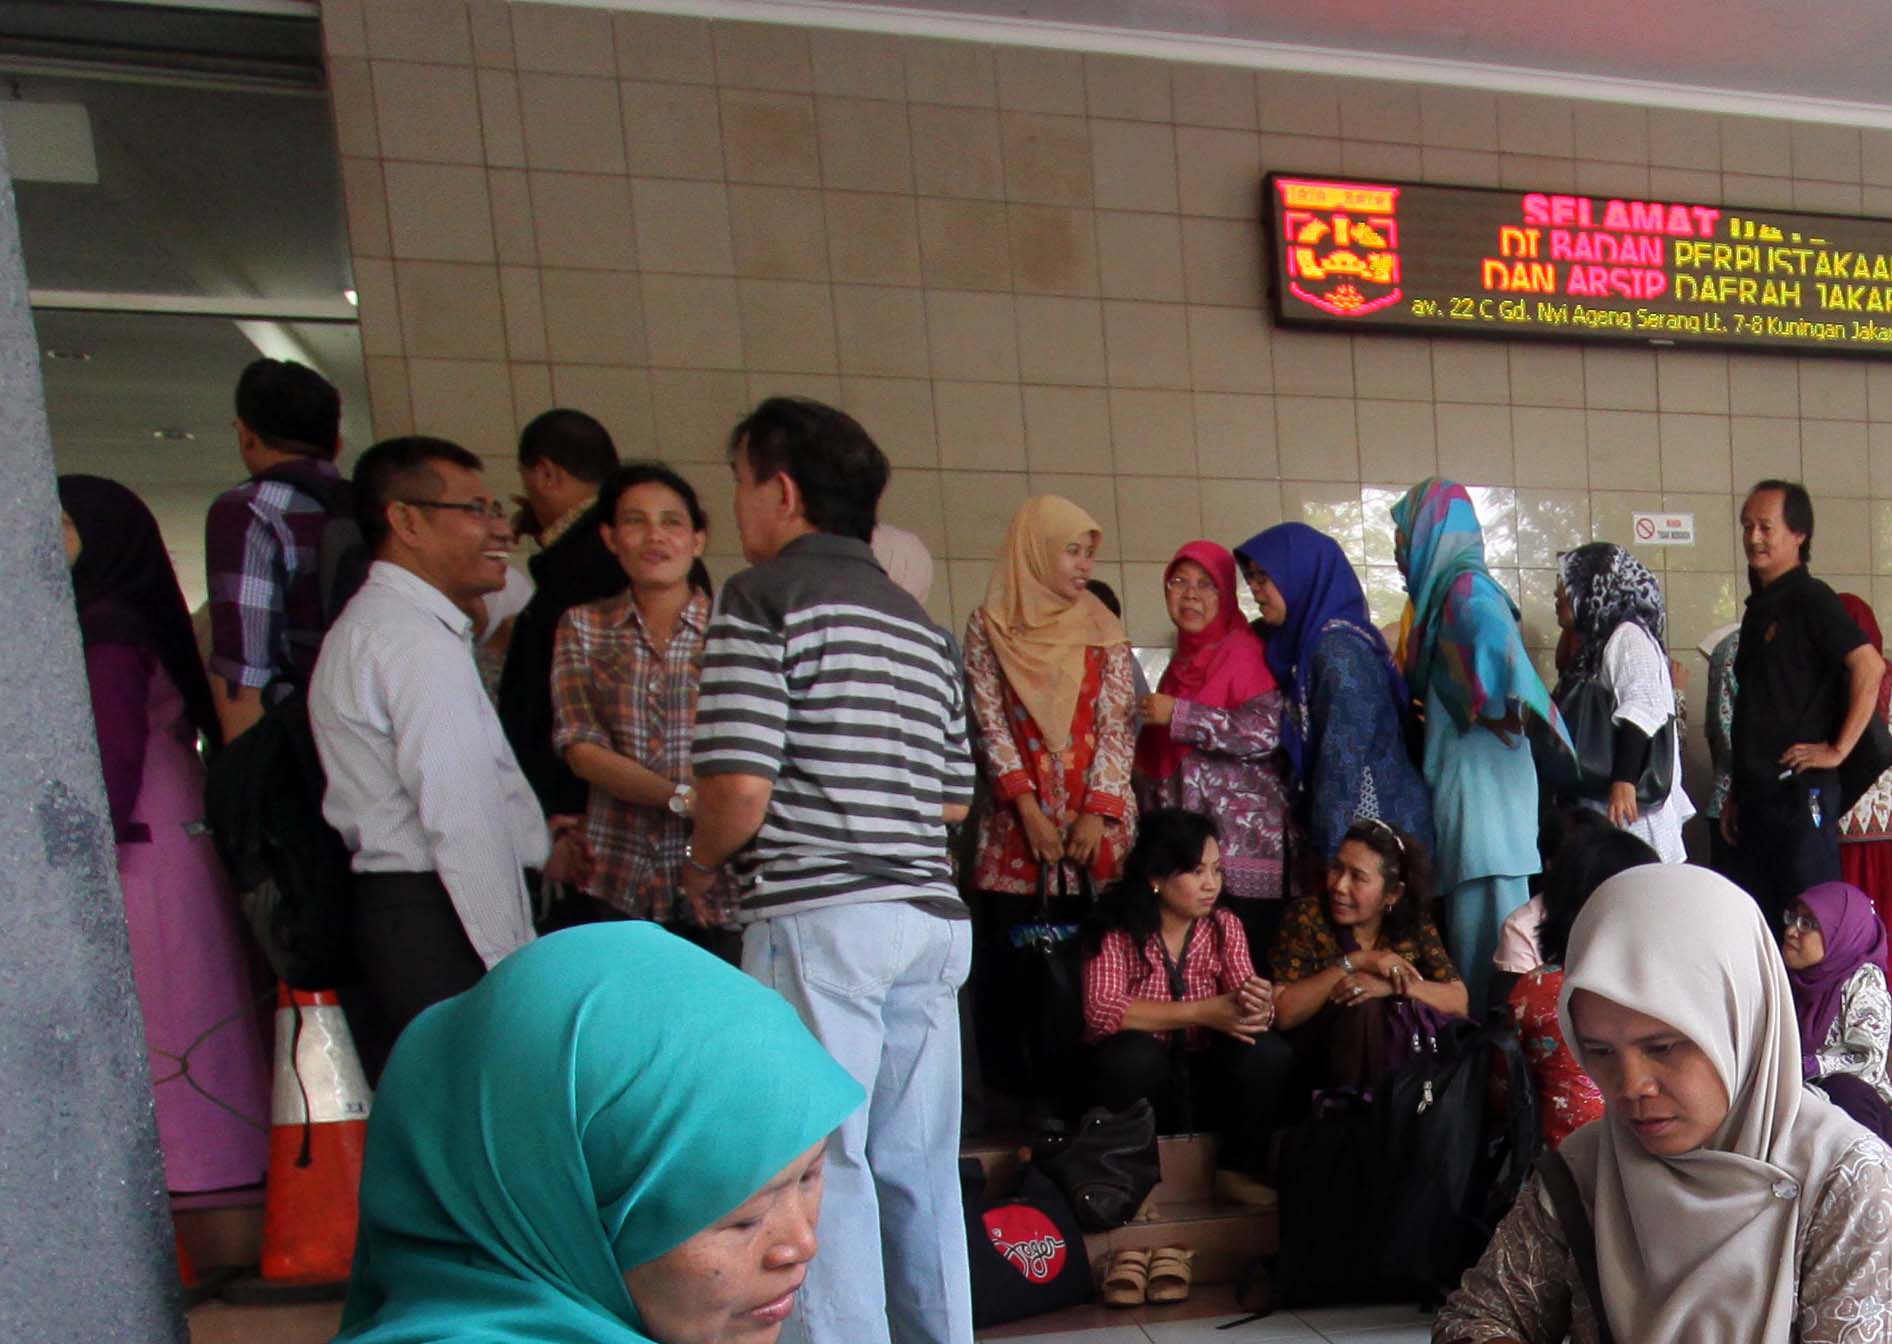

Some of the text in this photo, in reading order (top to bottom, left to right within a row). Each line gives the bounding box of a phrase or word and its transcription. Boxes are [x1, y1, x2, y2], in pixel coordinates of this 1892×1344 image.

[1481, 257, 1557, 295] DAN
[1450, 298, 1475, 319] 22
[1479, 299, 1494, 319] C
[1537, 303, 1569, 325] Nyi
[1573, 305, 1633, 330] Ageng
[1636, 308, 1699, 333] Serang
[1733, 314, 1763, 335] 7-8
[1767, 316, 1846, 341] Kuningan
